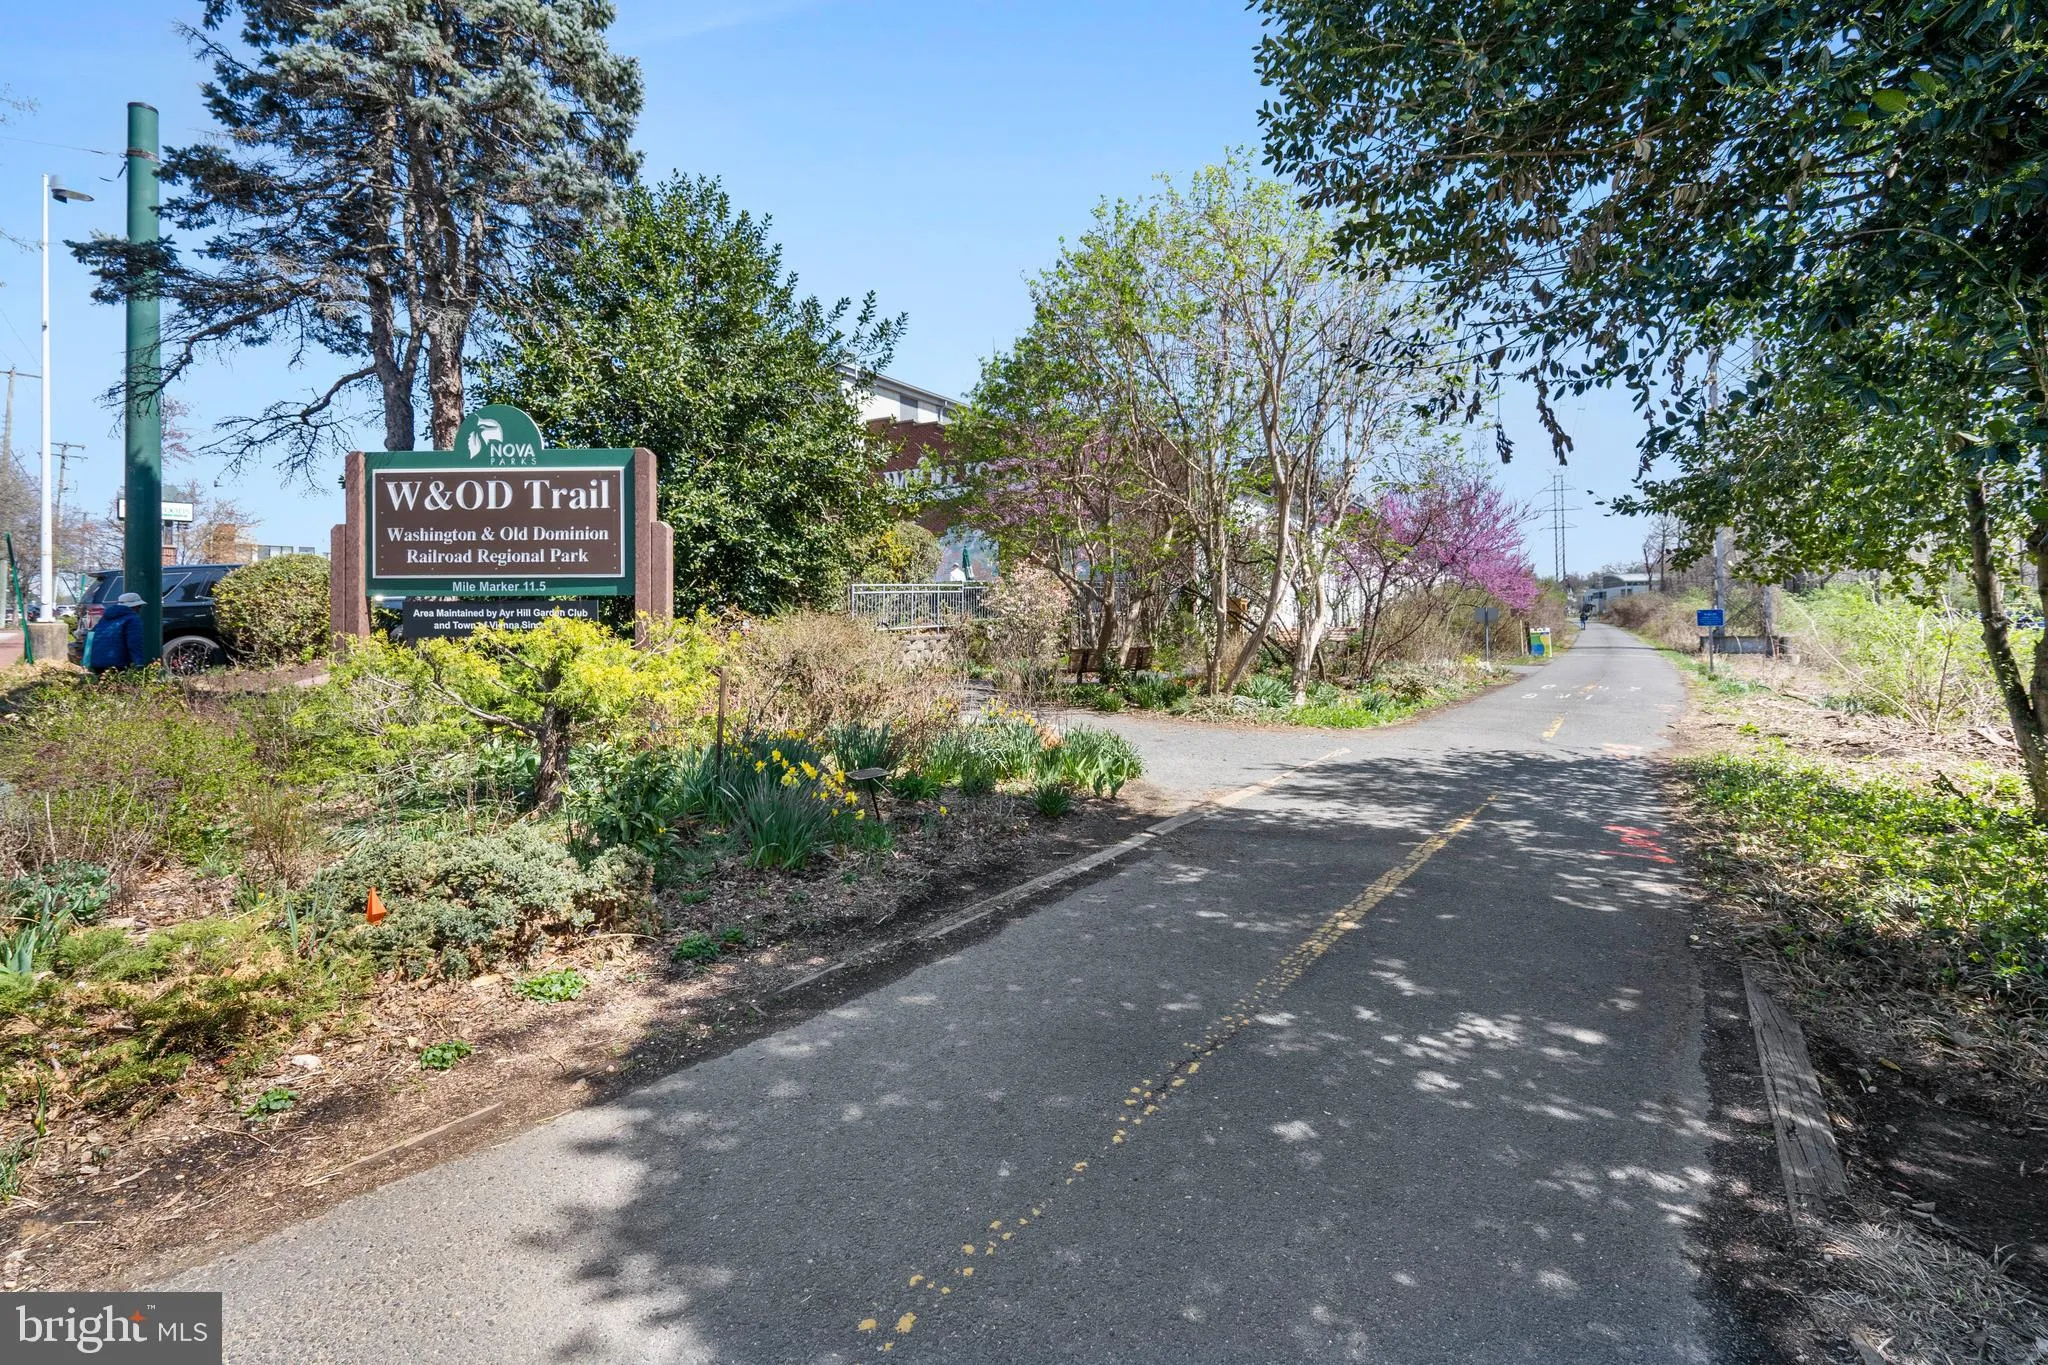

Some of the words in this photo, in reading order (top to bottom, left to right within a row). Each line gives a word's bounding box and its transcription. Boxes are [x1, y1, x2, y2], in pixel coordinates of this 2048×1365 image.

[491, 443, 535, 457] NOVA
[491, 457, 537, 466] PARKS
[385, 480, 513, 511] W&OD
[524, 479, 611, 510] Trail
[387, 527, 477, 545] Washington
[481, 527, 495, 541] &
[500, 526, 528, 541] Old
[533, 526, 609, 541] Dominion
[406, 549, 472, 563] Railroad
[477, 548, 545, 566] Regional
[550, 548, 589, 563] Park
[452, 581, 477, 592] Mile
[479, 581, 520, 592] Marker
[523, 581, 546, 591] 11.5
[413, 609, 434, 617] Area
[436, 608, 484, 617] Maintained
[486, 609, 497, 619] by
[499, 609, 514, 619] Ayr
[517, 608, 531, 617] Hill
[568, 608, 588, 617] Club
[434, 621, 450, 629] and
[489, 621, 519, 629] Vinna
